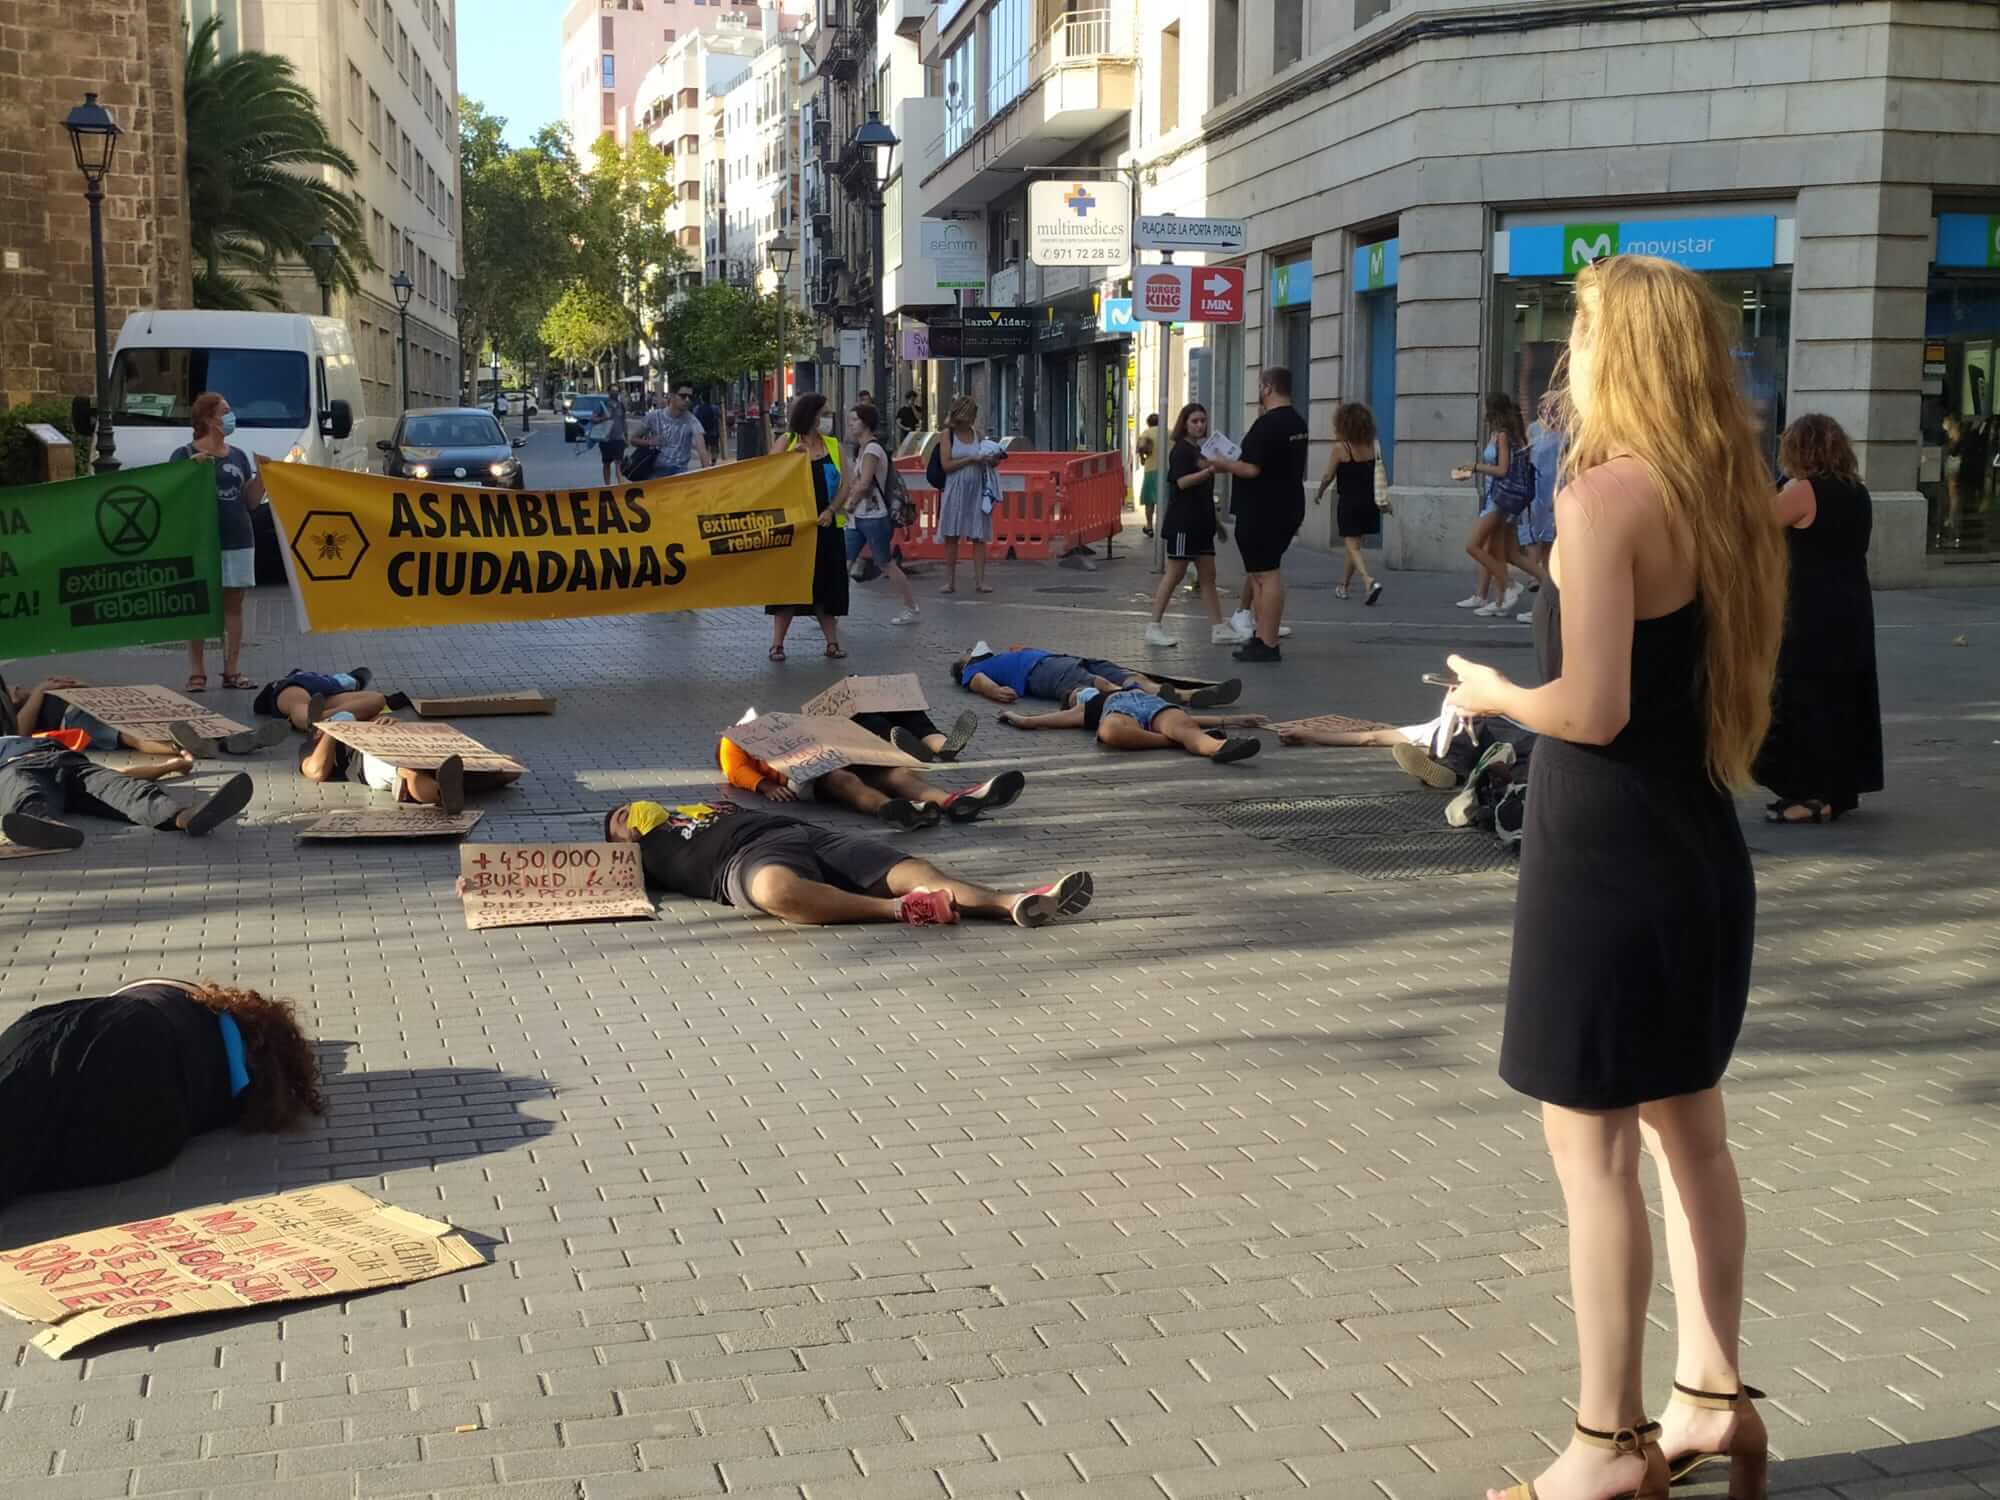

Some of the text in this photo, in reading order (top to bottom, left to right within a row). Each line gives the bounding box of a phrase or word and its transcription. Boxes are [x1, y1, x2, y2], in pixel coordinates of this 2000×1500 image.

[1037, 217, 1125, 236] multimedic.es
[1141, 222, 1242, 237] PLAÇA DE LA PORTA PINTADA
[1053, 248, 1121, 259] 971 72 28 52
[1626, 236, 1715, 254] movistar
[1145, 285, 1181, 294] BURGER
[1145, 294, 1181, 305] KING
[964, 318, 993, 326] Marco
[388, 487, 652, 538] ASAMBLEAS
[702, 512, 775, 533] extinction
[727, 529, 792, 552] rebellion
[65, 563, 179, 594] extinction
[387, 543, 687, 597] CIUDADANAS
[93, 590, 197, 620] rebellion
[611, 850, 637, 865] HA
[478, 872, 567, 888] BURNED
